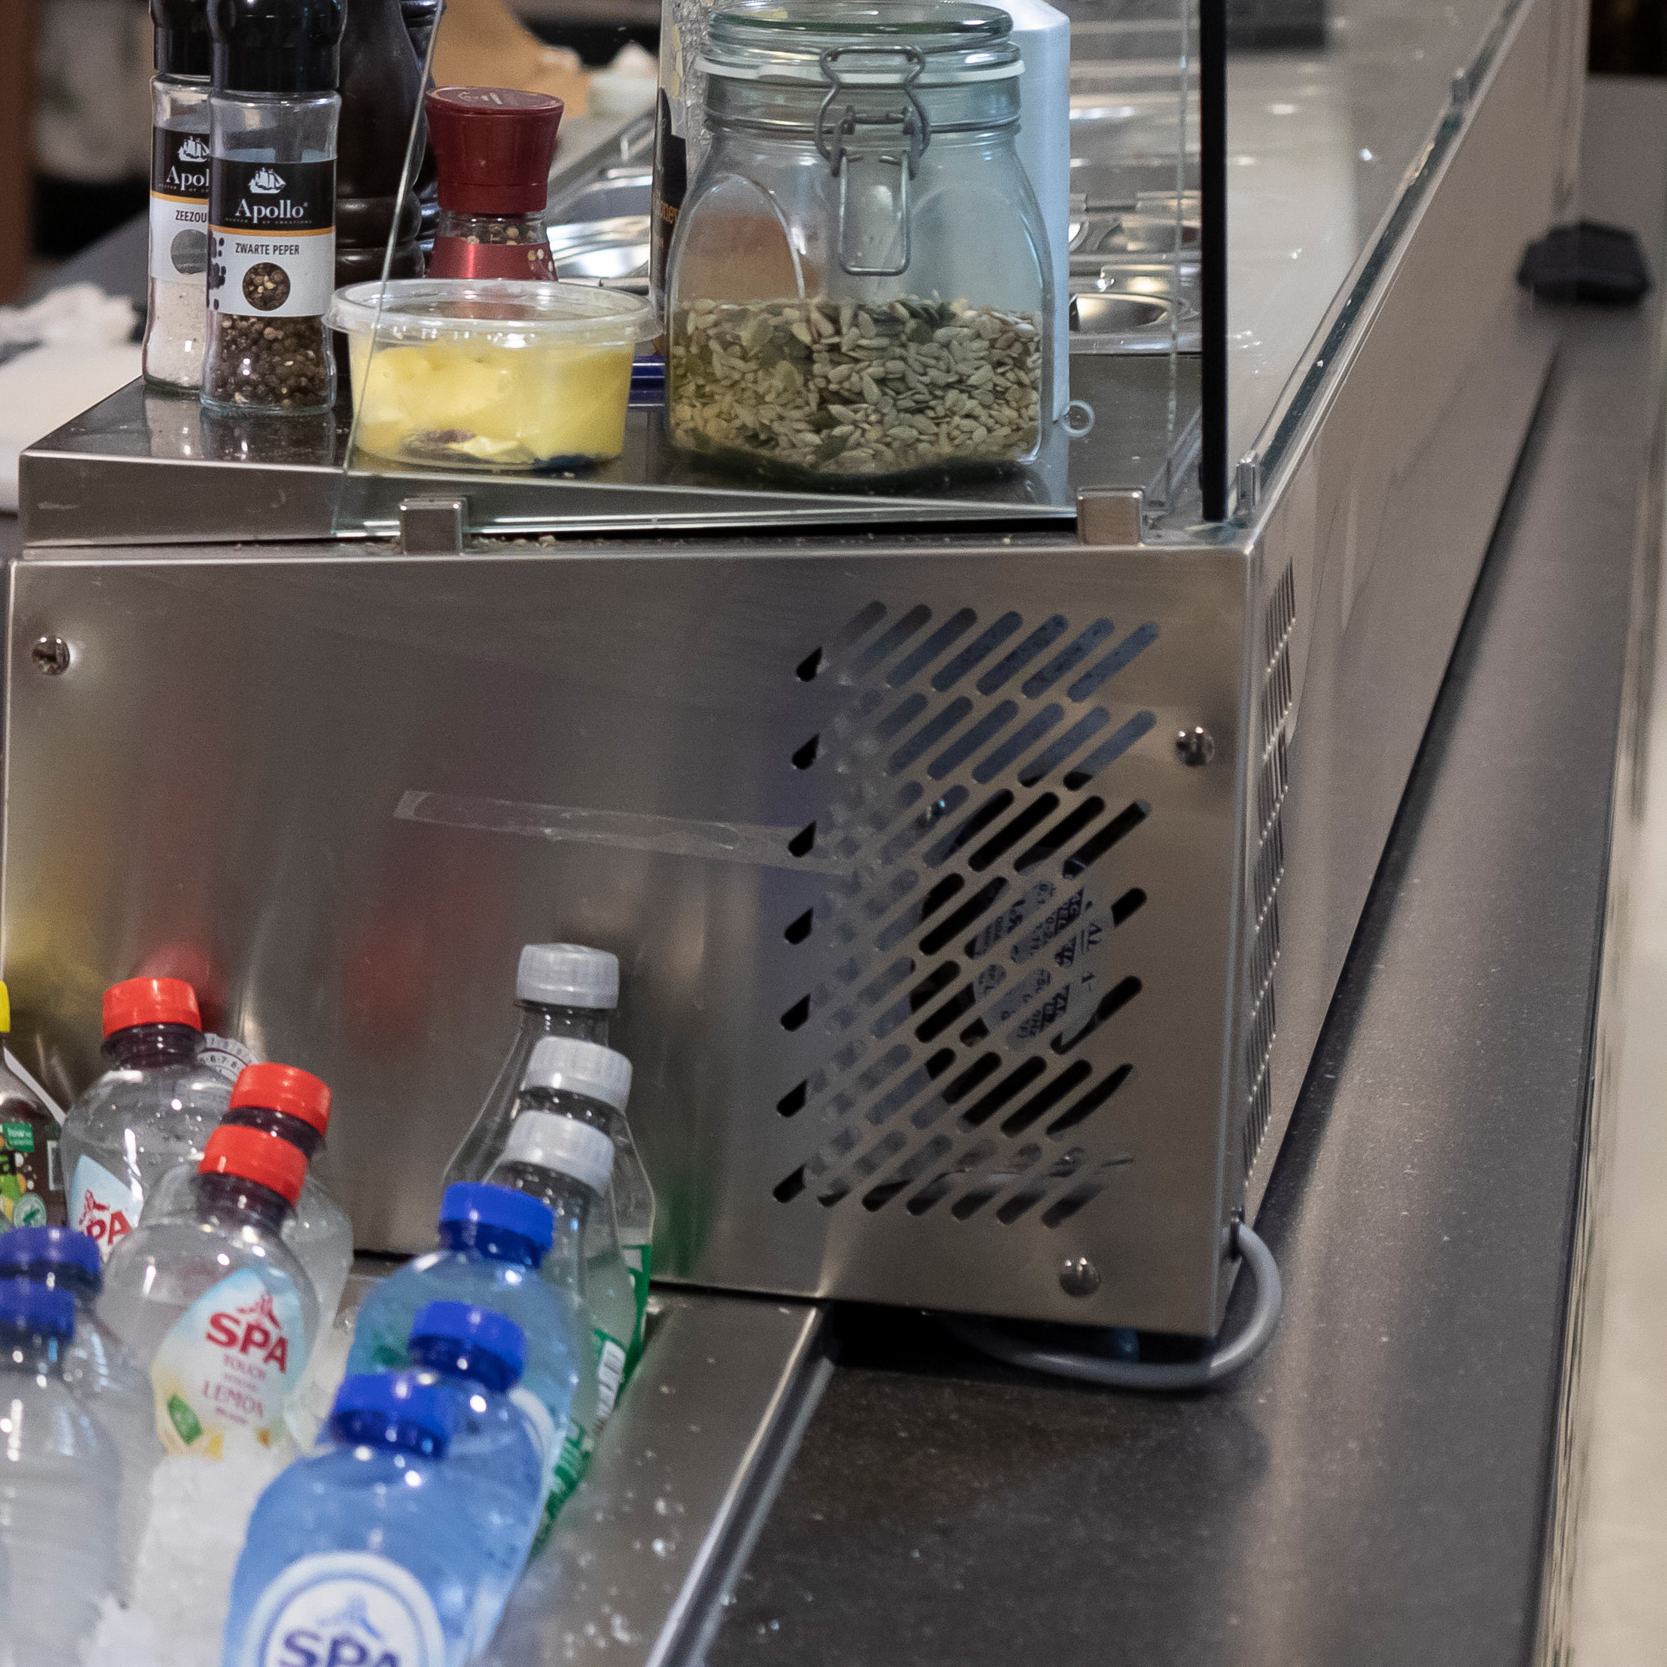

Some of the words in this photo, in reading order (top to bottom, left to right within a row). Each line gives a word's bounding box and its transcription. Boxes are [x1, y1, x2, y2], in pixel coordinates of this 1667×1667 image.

[166, 165, 210, 191] Apol
[175, 210, 207, 223] ZEEZOU
[234, 198, 304, 224] Apollo
[235, 242, 270, 255] ZWARTE
[273, 244, 300, 256] PEPER
[81, 1210, 131, 1246] PA
[204, 1311, 289, 1375] SPA
